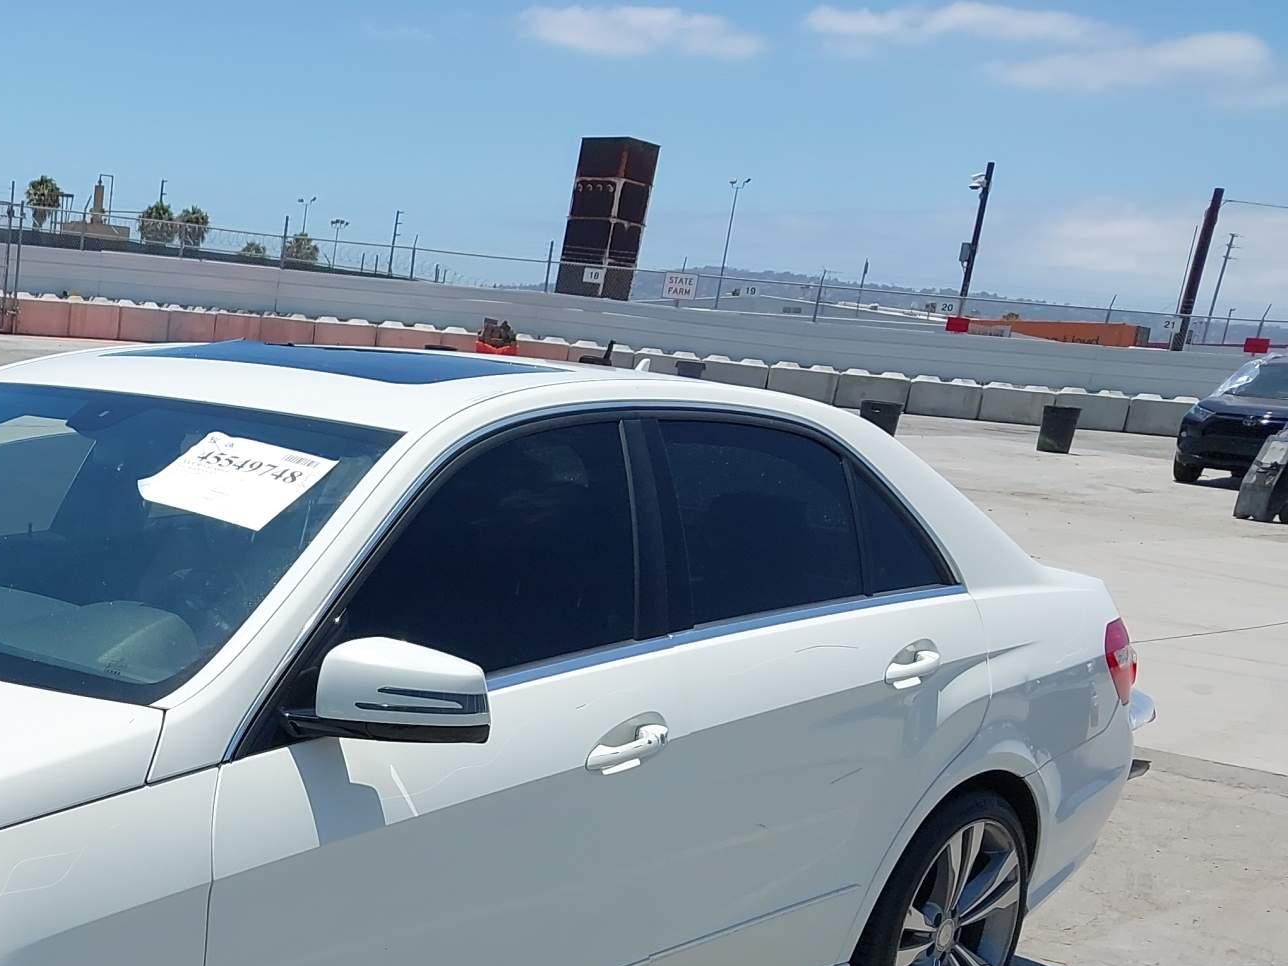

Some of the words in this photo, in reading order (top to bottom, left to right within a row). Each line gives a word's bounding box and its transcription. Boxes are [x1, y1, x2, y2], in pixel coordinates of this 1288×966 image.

[669, 276, 694, 286] STATE
[667, 286, 691, 296] FARM
[745, 287, 757, 296] 19
[941, 303, 954, 312] 20
[1164, 320, 1176, 329] 21
[196, 450, 304, 484] 45549748
